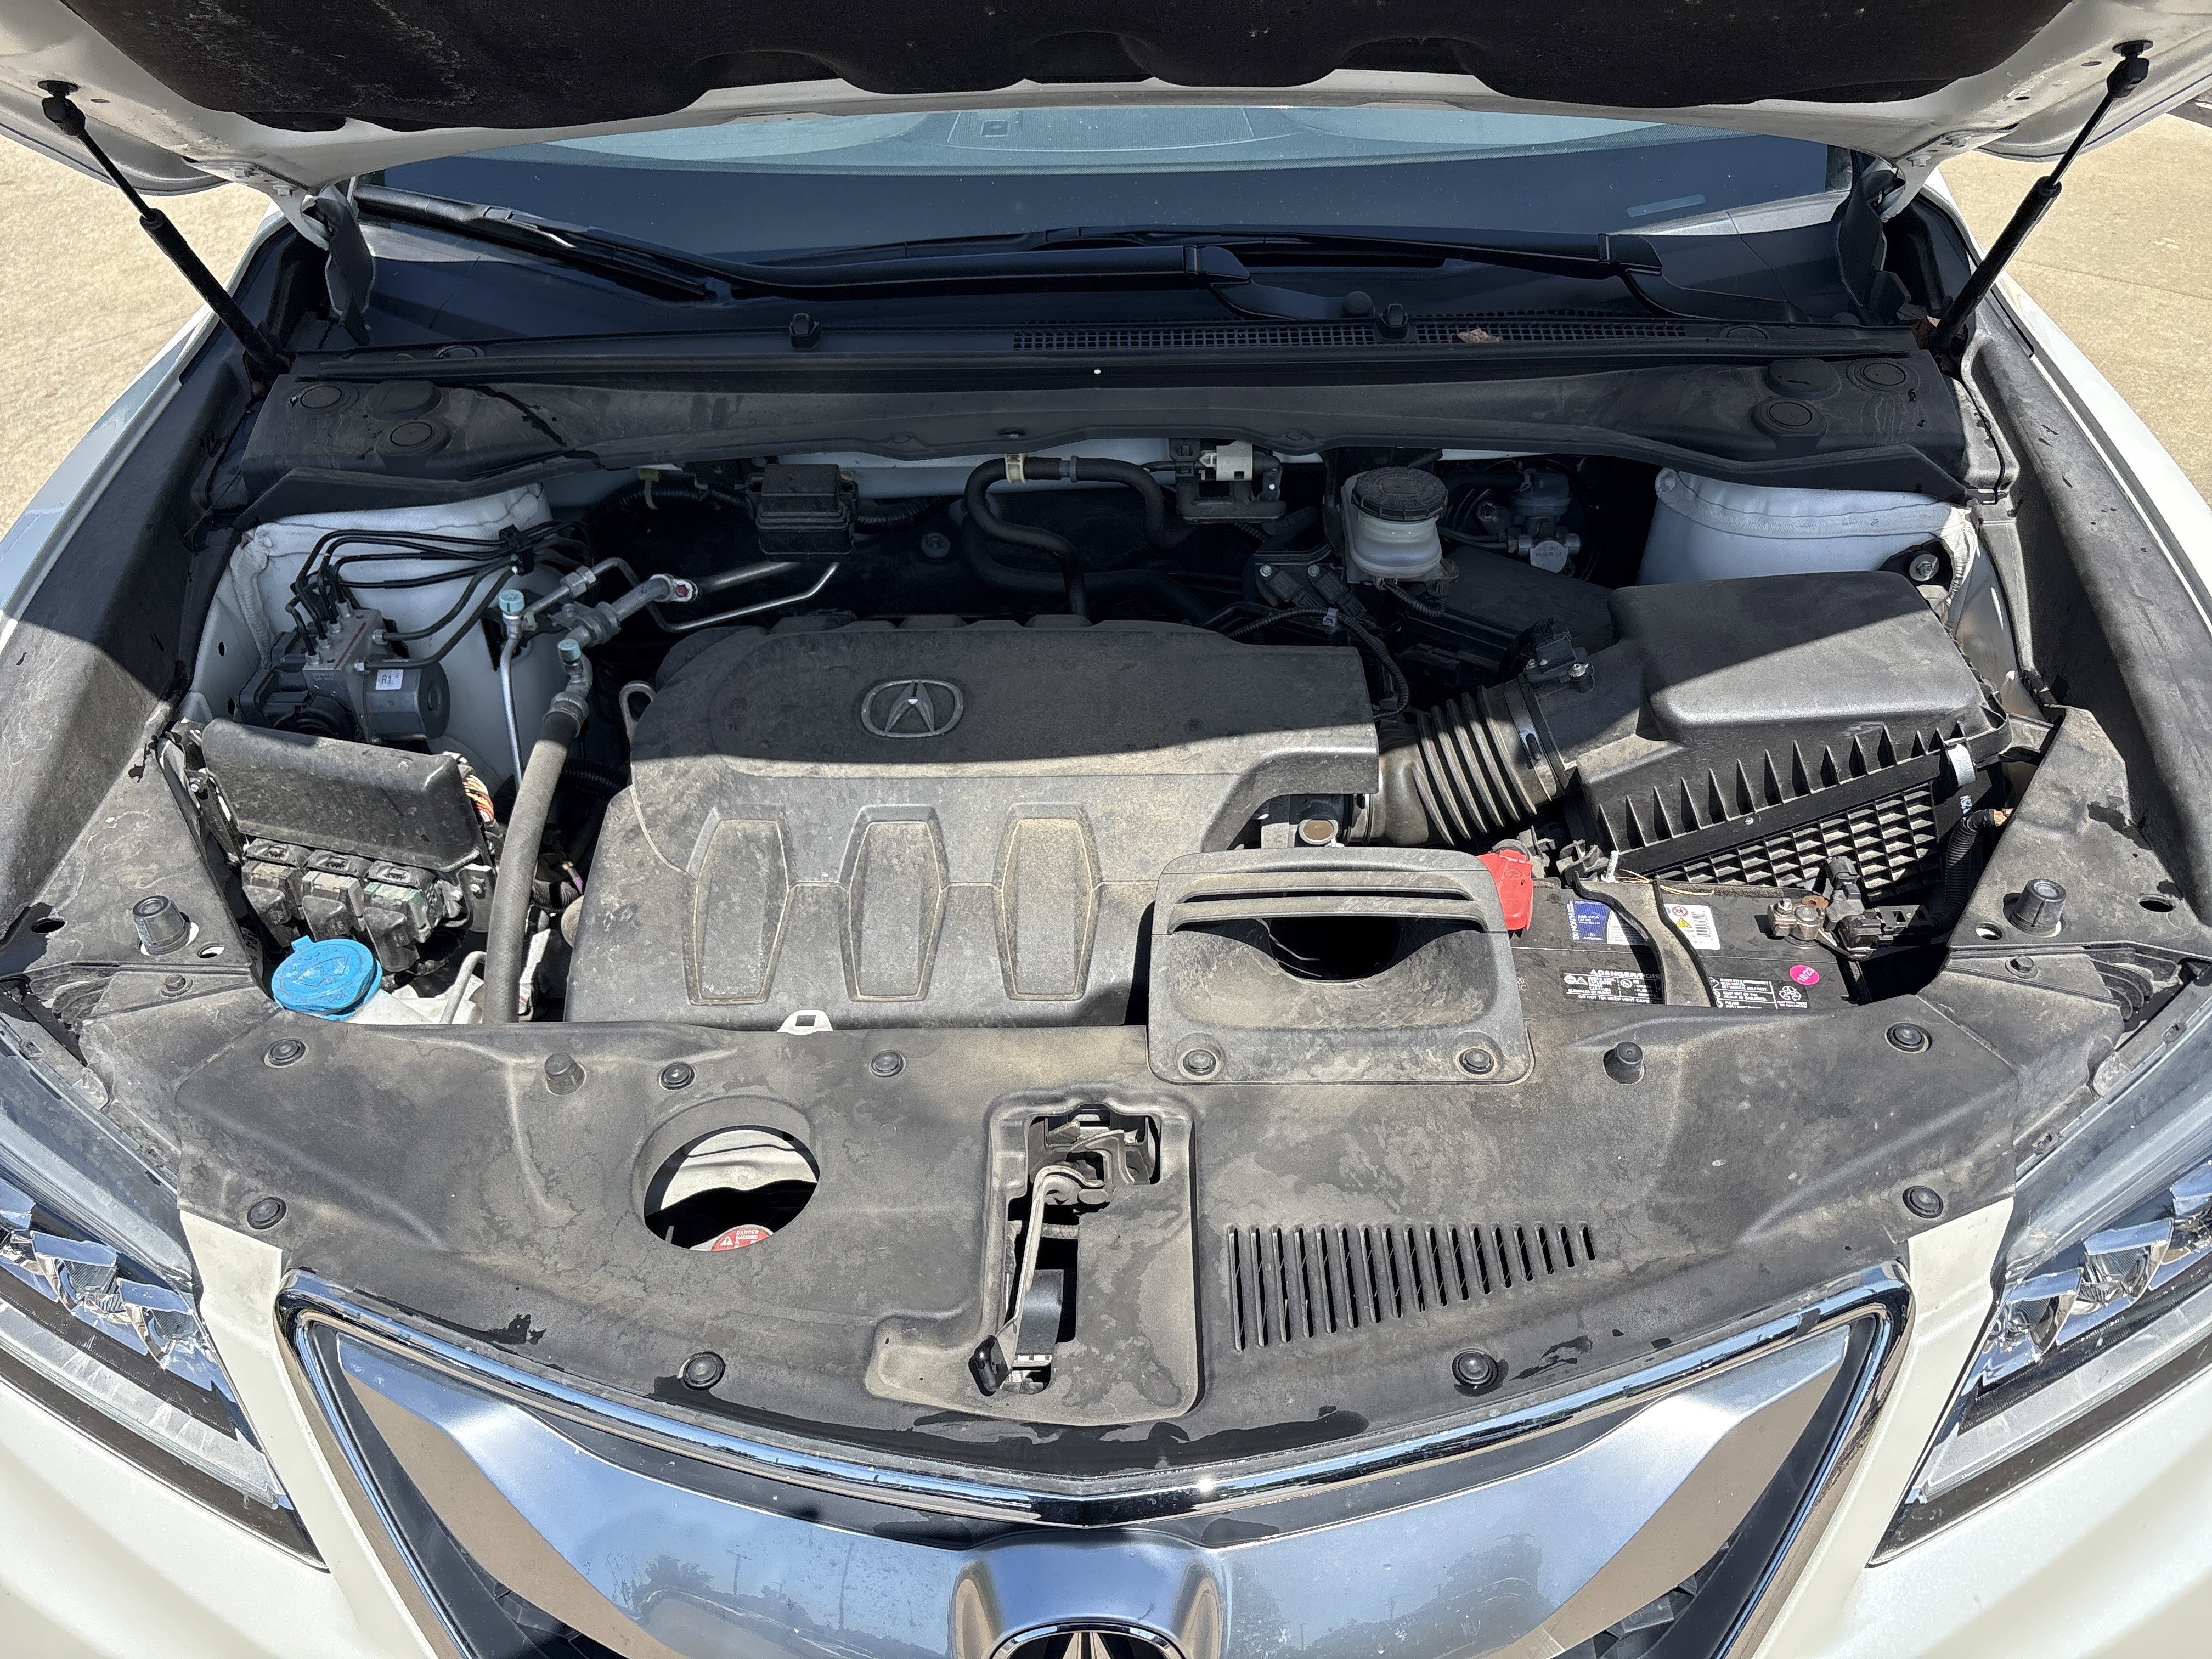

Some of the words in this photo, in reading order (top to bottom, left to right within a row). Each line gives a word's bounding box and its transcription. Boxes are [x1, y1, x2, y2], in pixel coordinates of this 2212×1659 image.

[381, 674, 392, 684] R1
[1568, 913, 1578, 932] MONTH
[1797, 967, 1815, 983] 10/23
